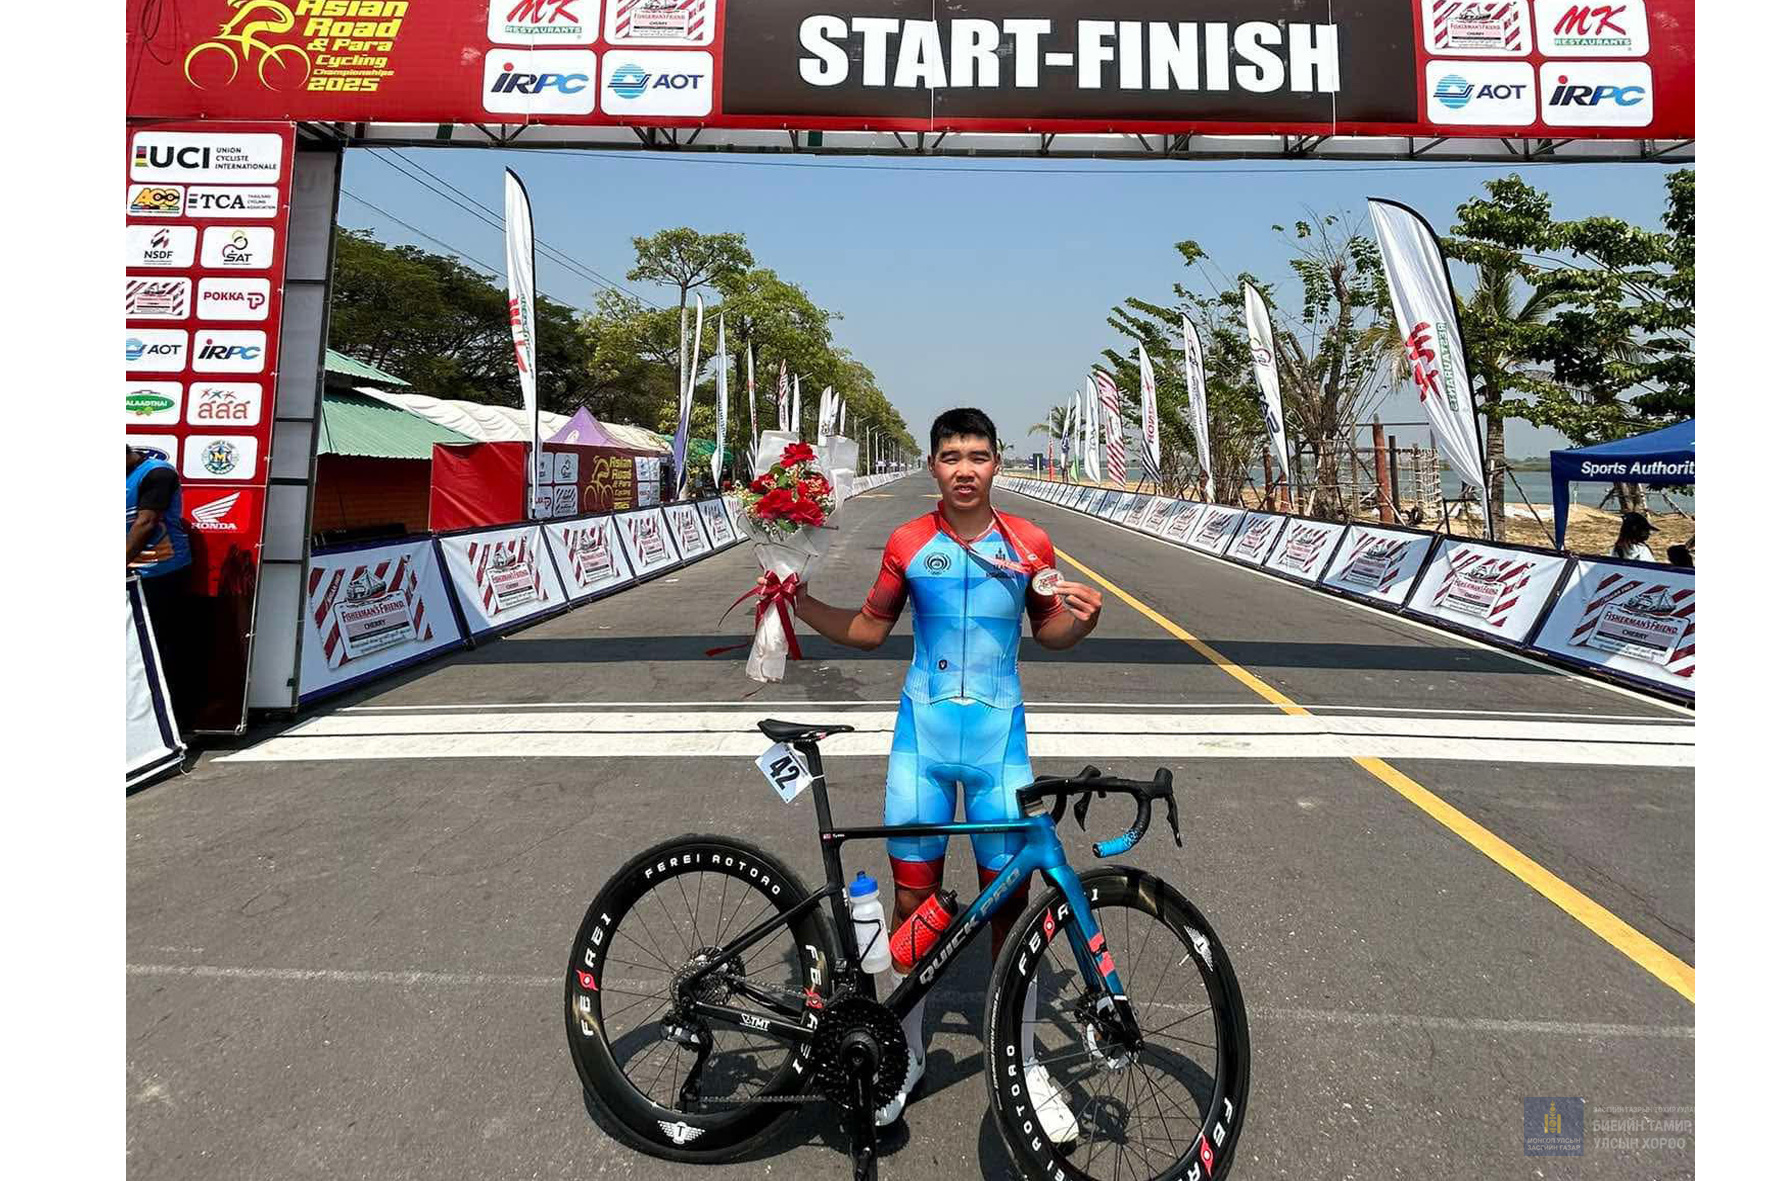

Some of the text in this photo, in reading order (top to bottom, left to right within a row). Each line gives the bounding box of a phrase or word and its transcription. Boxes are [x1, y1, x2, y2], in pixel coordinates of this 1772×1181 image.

[303, 18, 402, 38] Road
[1553, 4, 1627, 37] MK
[504, 25, 582, 35] RESTAURANTS
[306, 38, 394, 52] & Para
[1553, 37, 1632, 47] RESTAURANTS
[315, 53, 388, 69] Cycling
[799, 15, 1341, 93] START-FINISH
[313, 68, 395, 77] Championships
[306, 77, 381, 92] 2025
[652, 74, 705, 90] AOT
[1476, 84, 1527, 100] AOT
[149, 145, 211, 169] UCI
[200, 194, 246, 210] TCA
[144, 250, 174, 259] NSDF
[224, 252, 253, 262] SAT
[203, 291, 245, 301] POKKA
[147, 344, 182, 355] AOT
[1581, 461, 1695, 477] Sports Authorit
[191, 522, 238, 530] HONDA
[1622, 629, 1649, 640] CHERRY
[1650, 620, 1679, 635] FRIEND
[770, 755, 800, 790] 42
[644, 852, 701, 880] FEREI
[919, 867, 1021, 985] QUICK PRO
